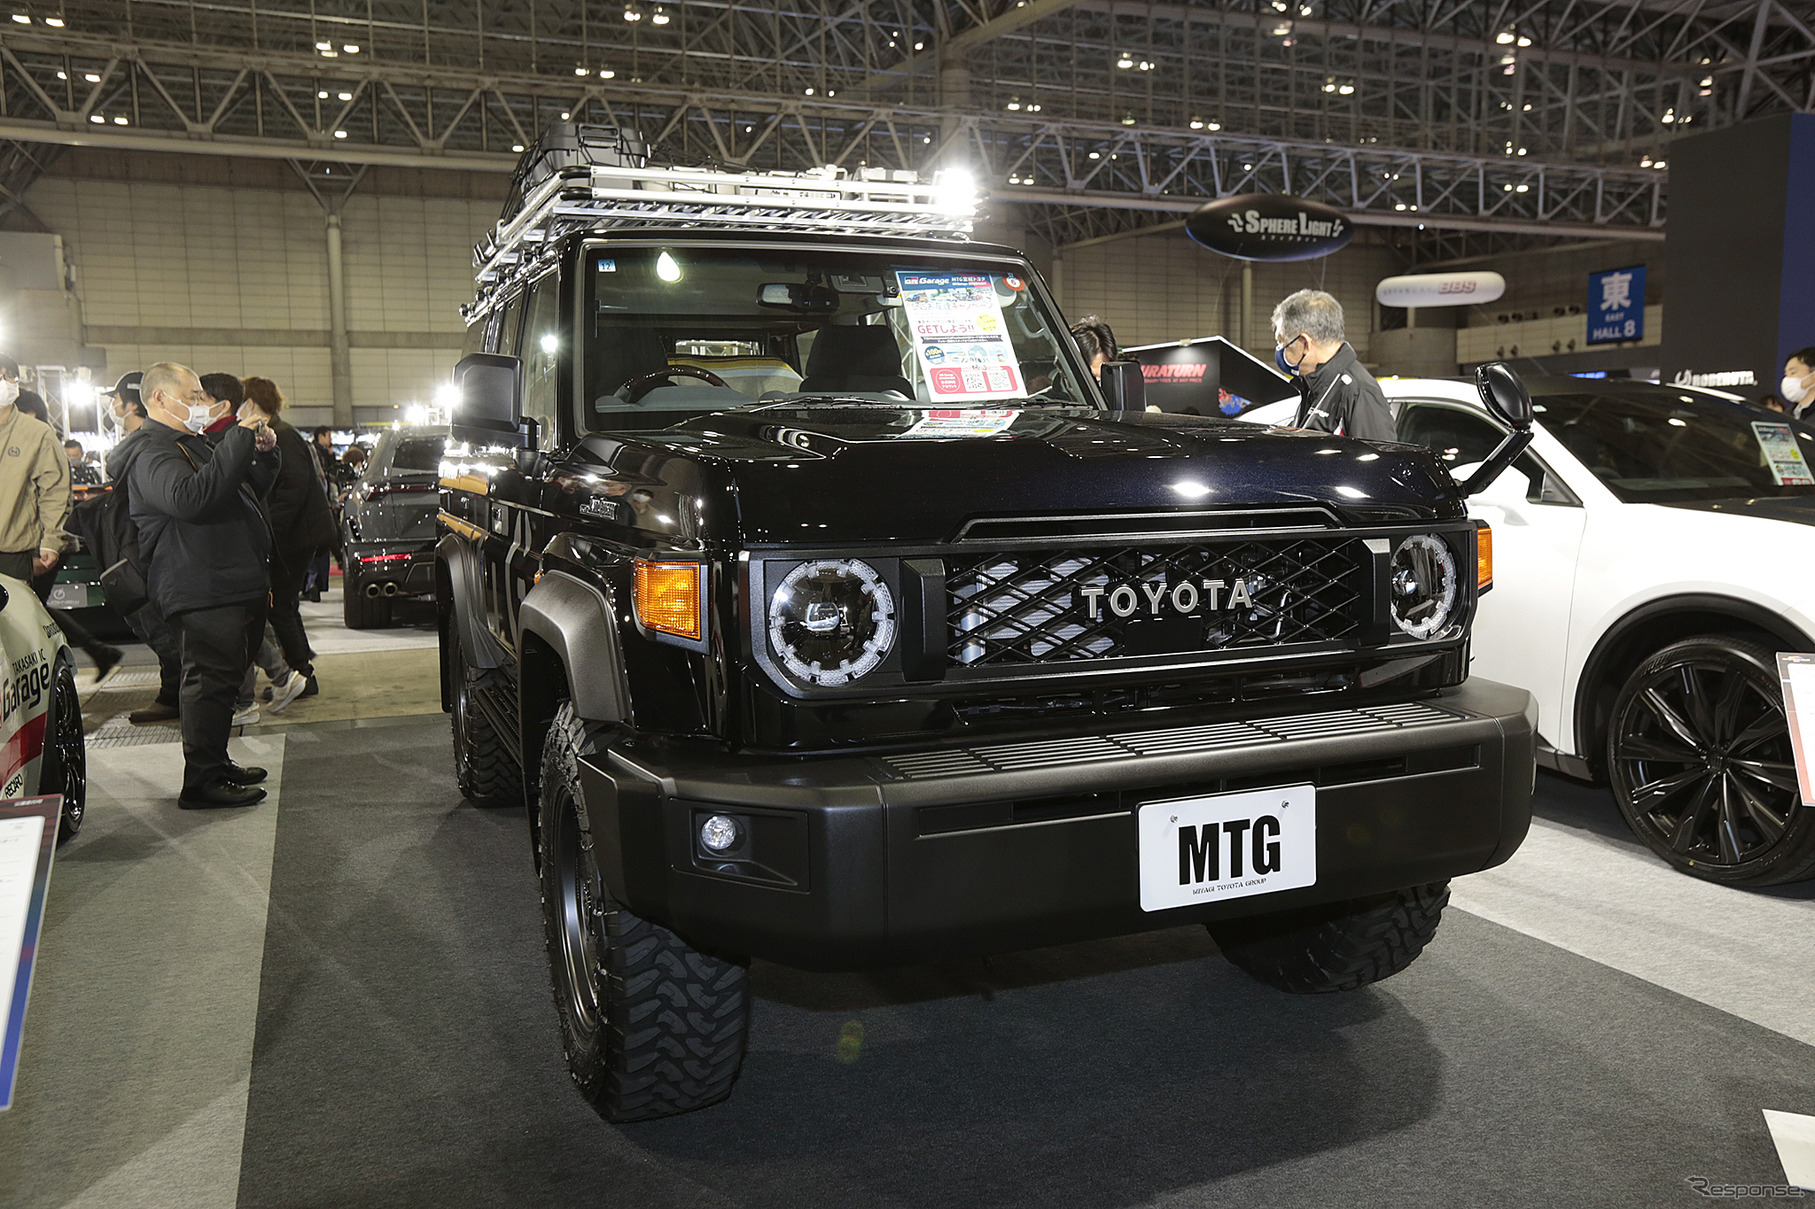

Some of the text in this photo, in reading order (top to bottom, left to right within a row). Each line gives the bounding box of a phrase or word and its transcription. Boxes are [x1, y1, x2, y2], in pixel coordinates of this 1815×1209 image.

[1245, 209, 1333, 237] SPHERE LIGHT
[919, 277, 950, 286] Garage
[1438, 280, 1477, 295] BBS
[1600, 271, 1633, 311] 東
[1592, 319, 1636, 341] HALL 8
[1140, 363, 1208, 378] URATURN
[1080, 578, 1253, 619] TOYOTA
[12, 648, 47, 676] TAKASAKI IC
[3, 662, 50, 723] Garage
[1178, 814, 1281, 886] MTG
[1192, 877, 1267, 895] MIYAGI TOYOTA GROUP
